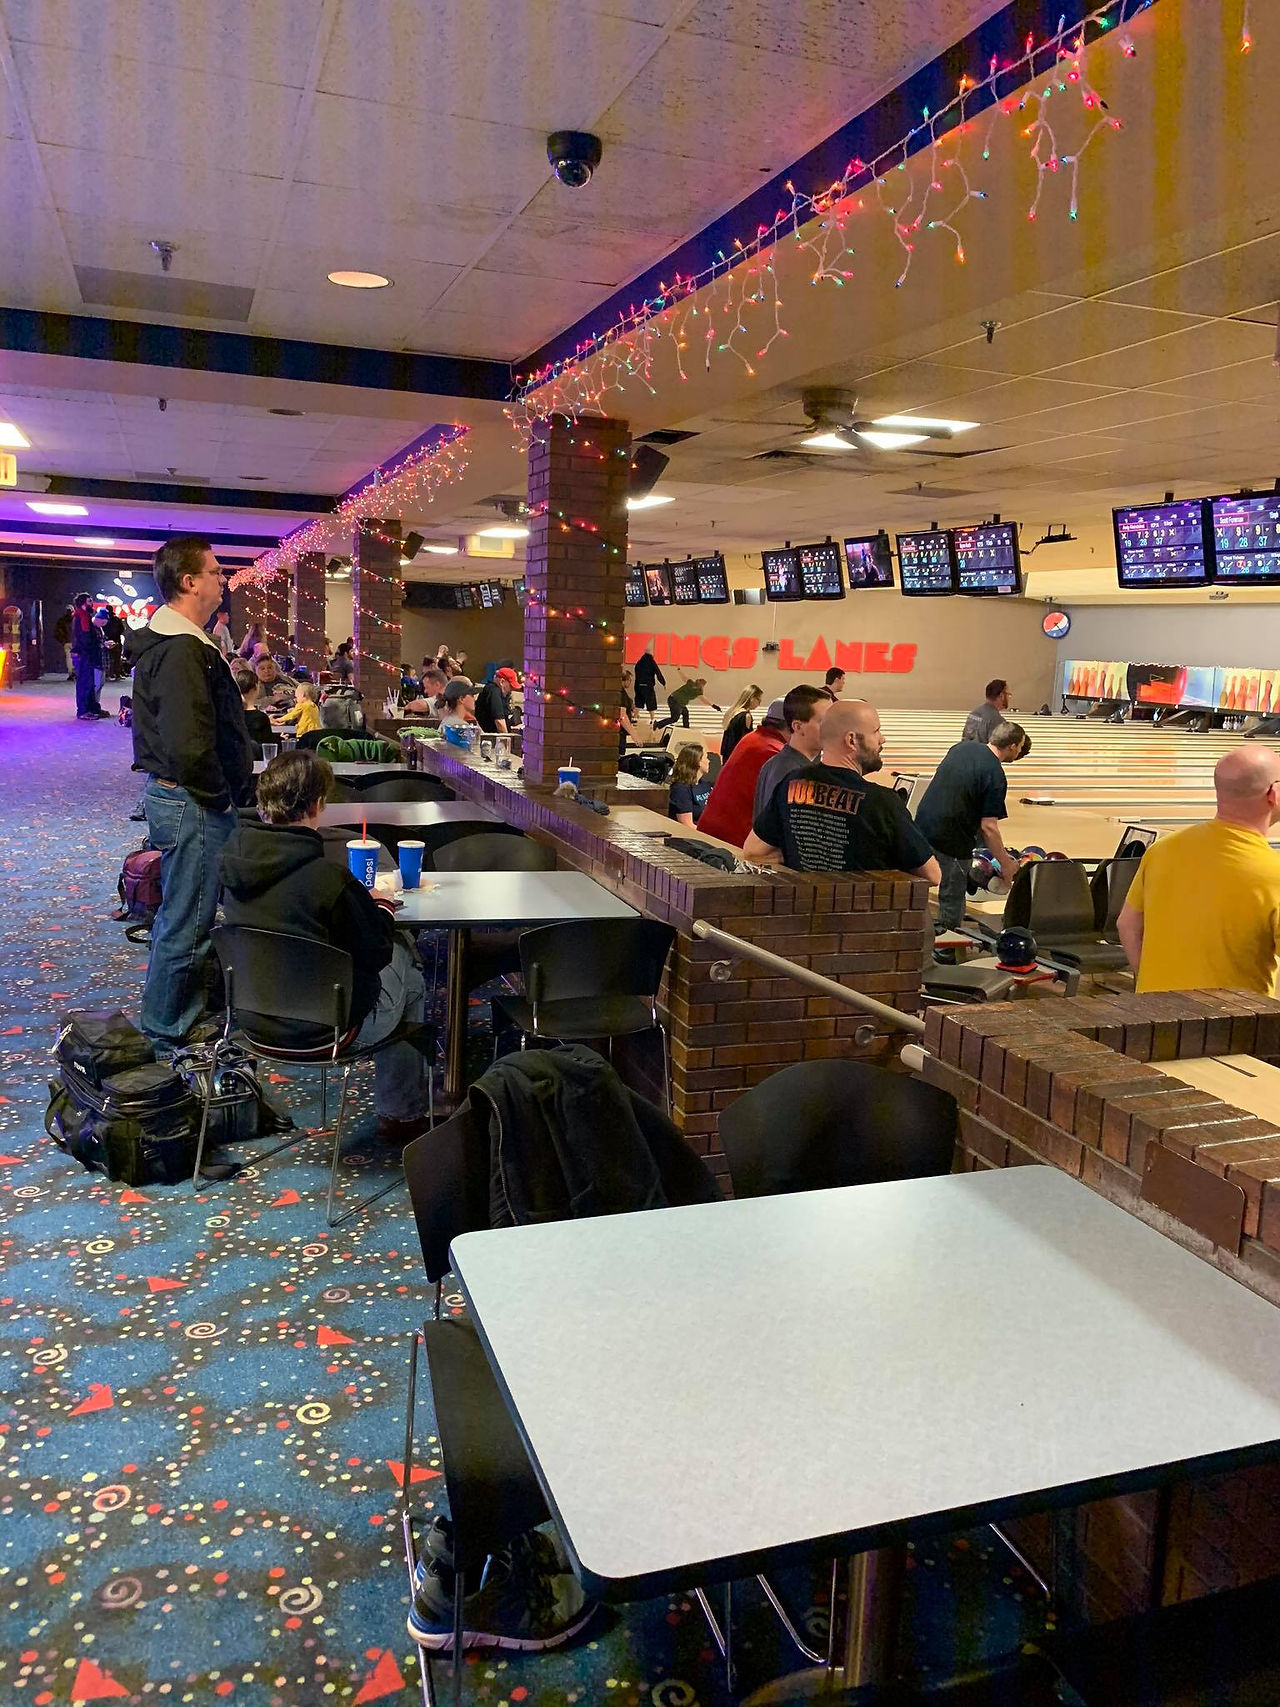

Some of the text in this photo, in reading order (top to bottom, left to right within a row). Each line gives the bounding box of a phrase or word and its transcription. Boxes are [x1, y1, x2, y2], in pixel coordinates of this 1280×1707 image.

[1221, 536, 1267, 548] 19 28 37
[624, 632, 917, 673] KINGS LANES
[365, 858, 374, 887] pepsi
